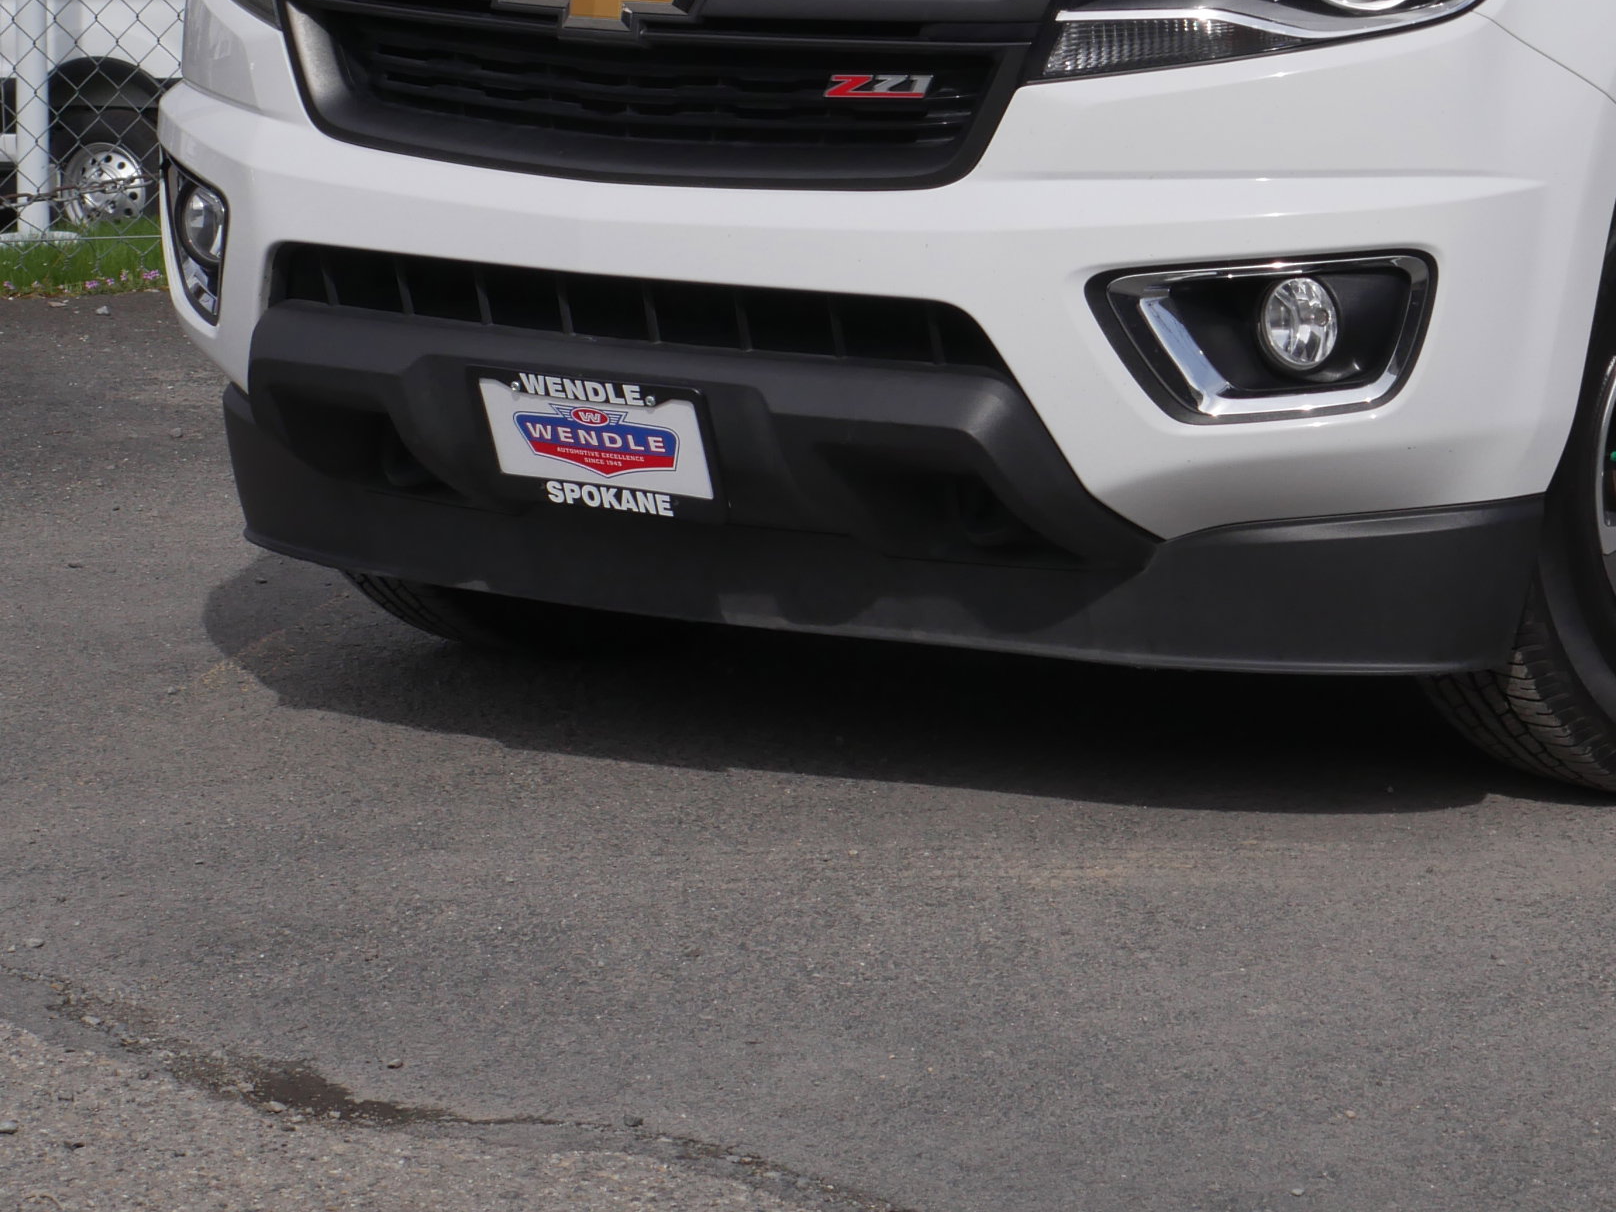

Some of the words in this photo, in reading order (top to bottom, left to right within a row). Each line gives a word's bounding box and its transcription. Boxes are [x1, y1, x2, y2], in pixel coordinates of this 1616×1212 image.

[823, 74, 935, 99] Z71
[519, 372, 646, 406] WENDLE
[526, 422, 666, 452] WENDLE
[556, 446, 600, 458] AUTOMOTIVE
[601, 452, 645, 462] EXCELLENCE
[584, 457, 605, 465] SINCE
[546, 481, 674, 517] SPOKANE
